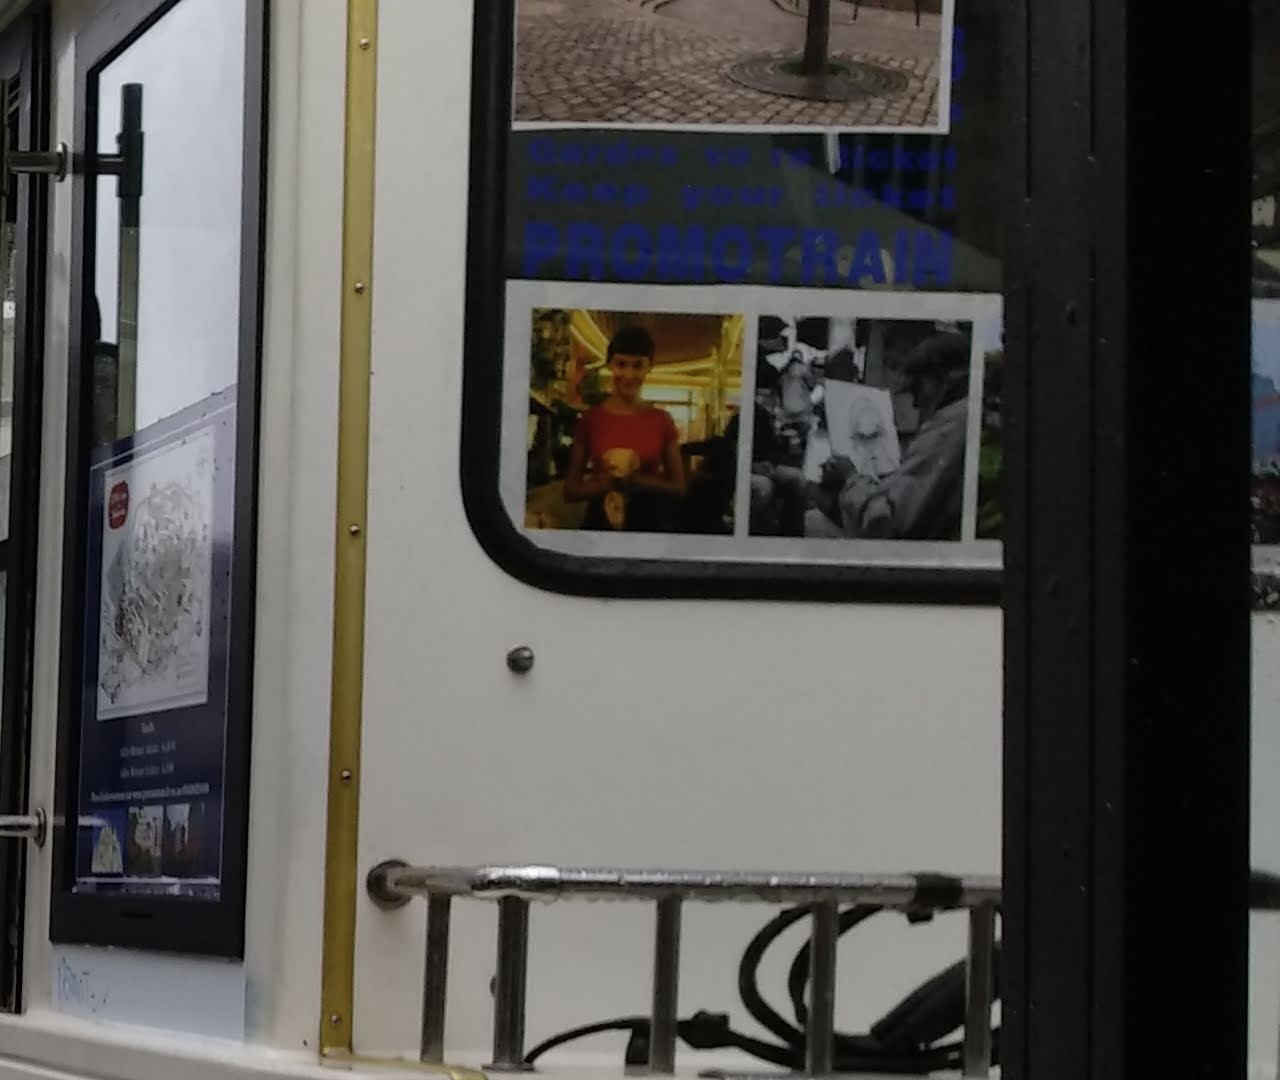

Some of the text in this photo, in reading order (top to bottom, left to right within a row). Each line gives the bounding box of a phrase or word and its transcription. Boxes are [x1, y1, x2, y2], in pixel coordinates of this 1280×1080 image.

[837, 144, 958, 173] ticket
[526, 175, 958, 213] Keep your ticket
[522, 222, 954, 286] PROMOTRAIN
